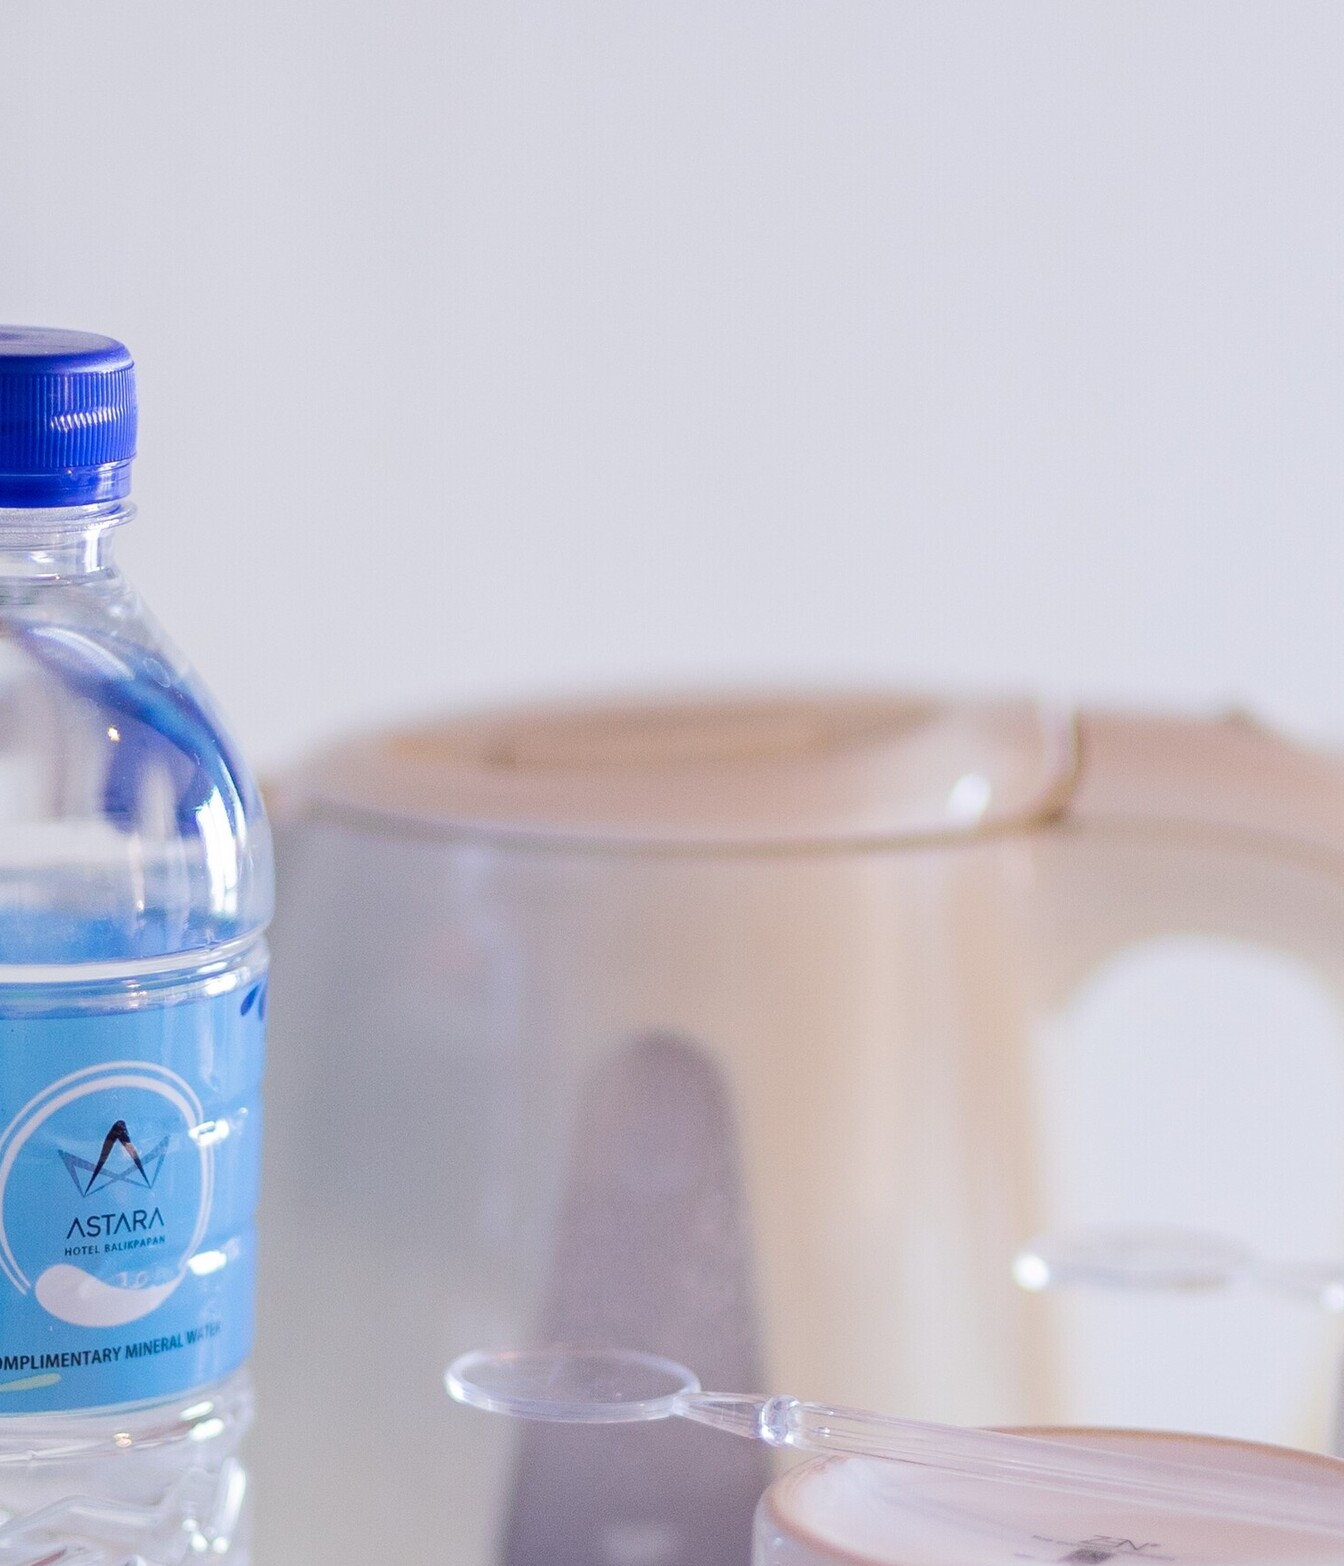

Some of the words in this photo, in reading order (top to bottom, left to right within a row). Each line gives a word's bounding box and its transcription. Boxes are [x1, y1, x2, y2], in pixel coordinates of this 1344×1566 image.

[65, 1206, 165, 1240] ASTARA
[64, 1244, 101, 1257] HOTEL
[103, 1235, 167, 1254] BALIKPAPAN
[124, 1334, 184, 1361] MINERAL
[185, 1320, 222, 1346] WATER
